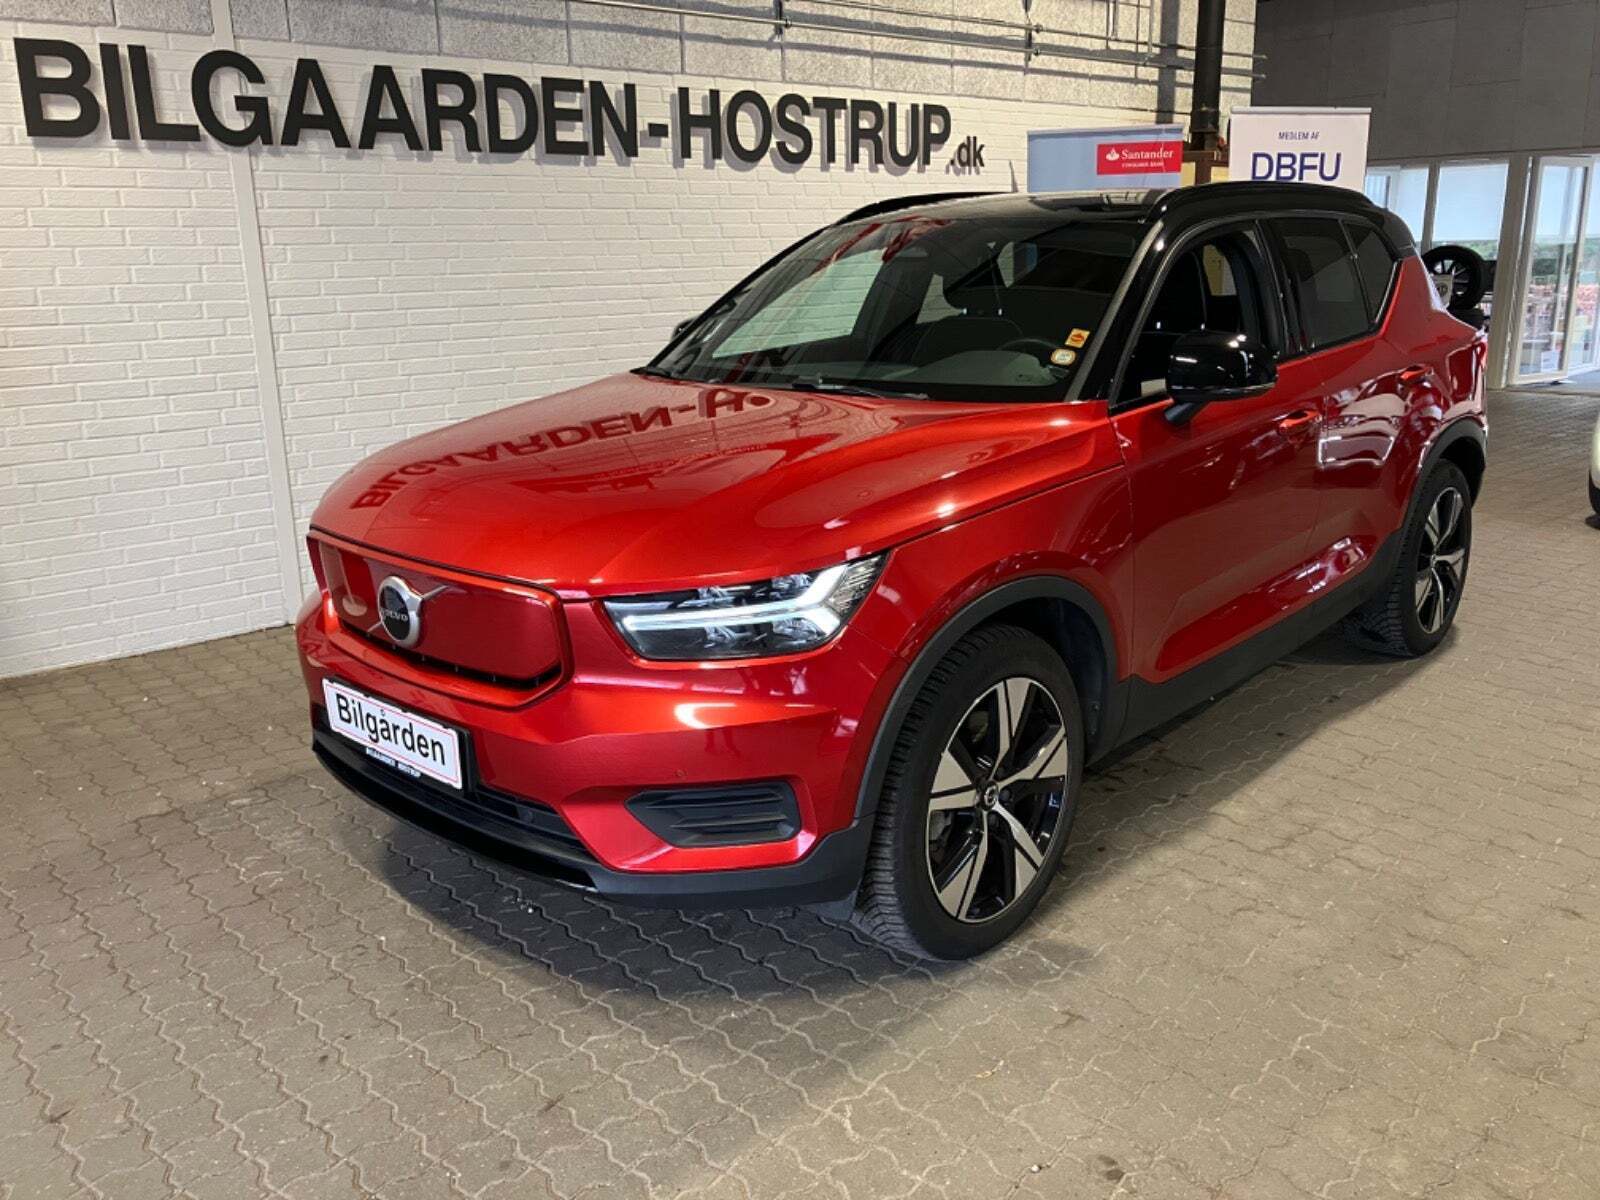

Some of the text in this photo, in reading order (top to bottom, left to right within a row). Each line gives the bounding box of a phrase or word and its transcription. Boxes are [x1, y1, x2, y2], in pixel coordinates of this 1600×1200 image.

[1278, 131, 1320, 140] MEDLEM AF
[1121, 146, 1174, 160] Santander
[1251, 152, 1342, 182] DBFU
[336, 693, 446, 766] Bilgården
